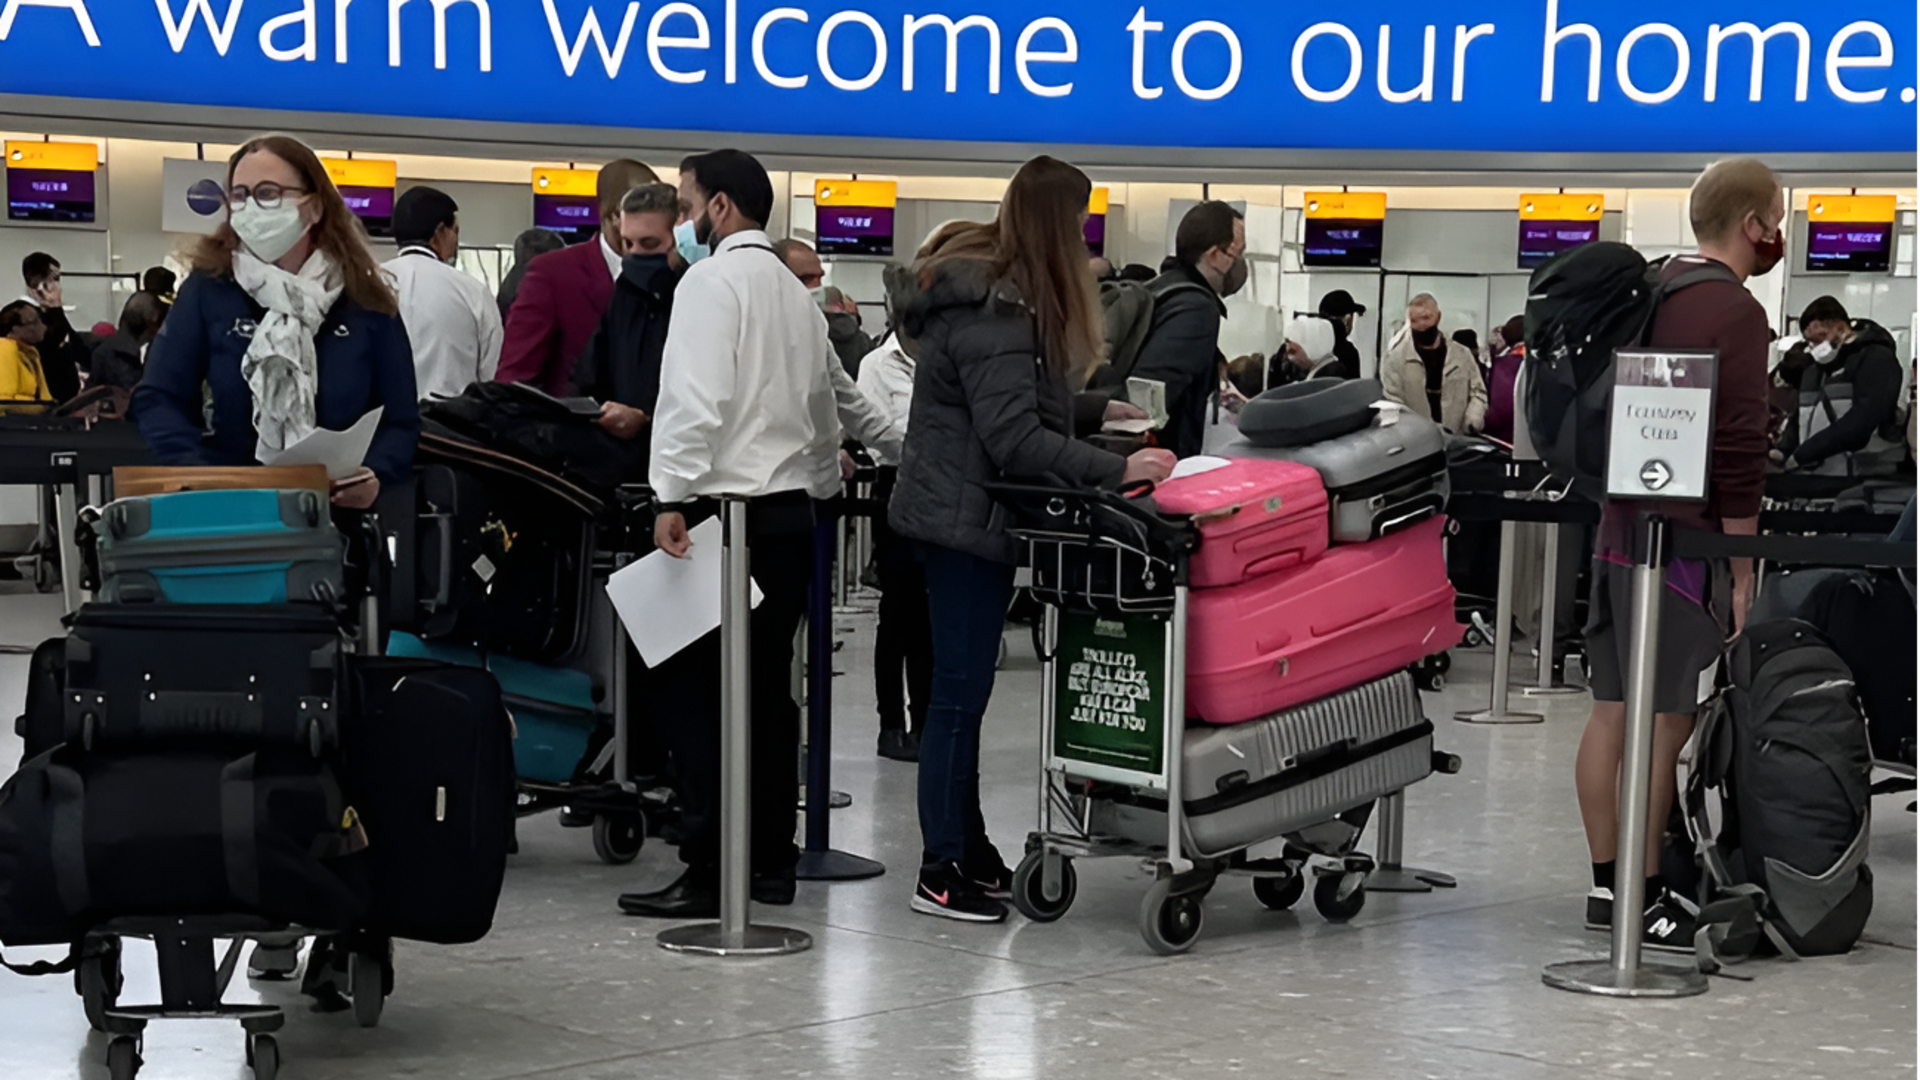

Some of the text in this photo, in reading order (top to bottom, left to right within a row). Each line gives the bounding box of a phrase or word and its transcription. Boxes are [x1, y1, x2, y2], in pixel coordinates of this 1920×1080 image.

[154, 0, 492, 72] warm
[541, 0, 1078, 98] welcome
[1125, 5, 1243, 101] to
[1290, 21, 1495, 104] our
[1540, 0, 1917, 105] home.
